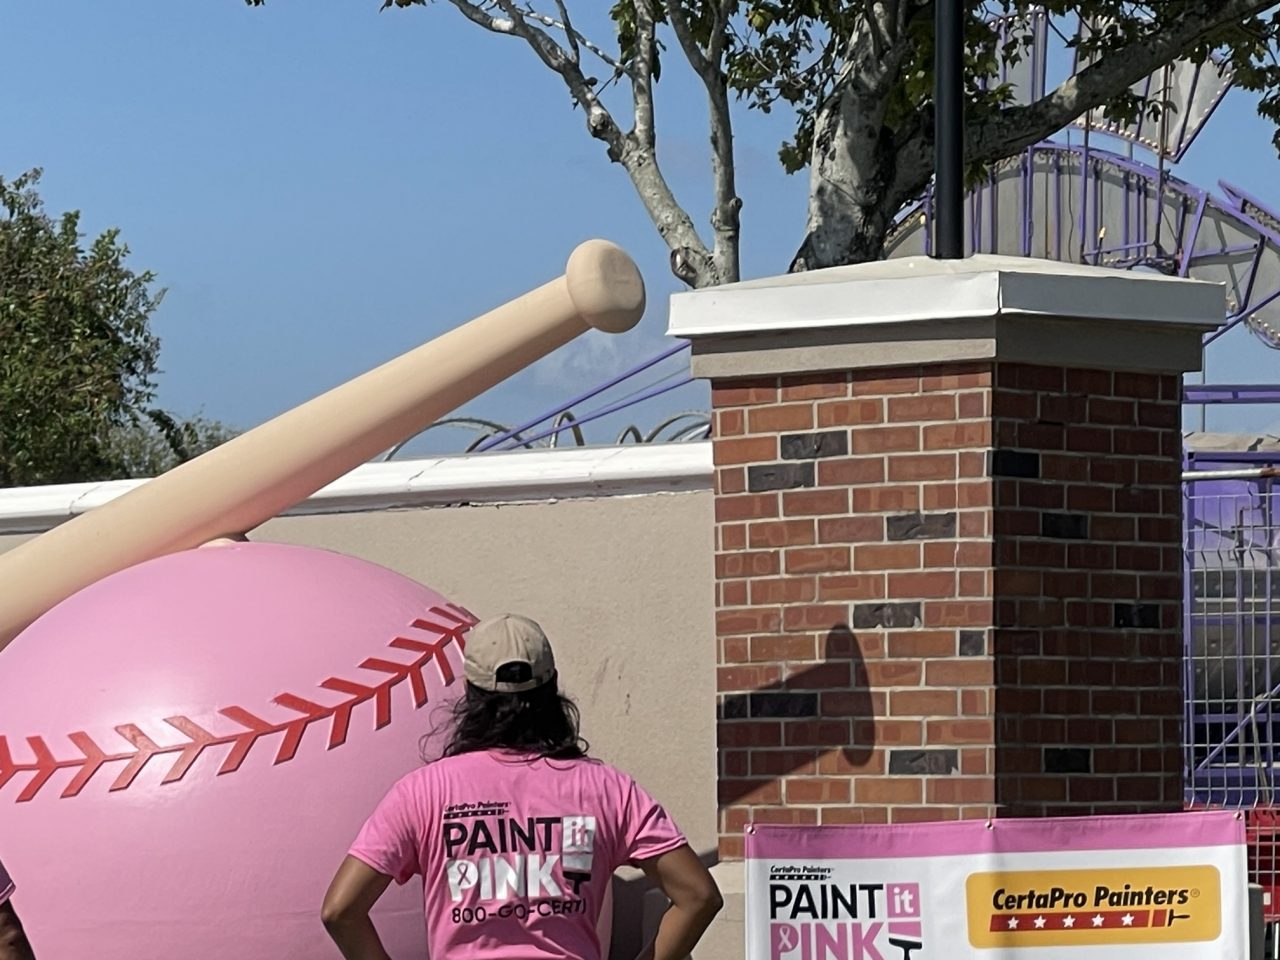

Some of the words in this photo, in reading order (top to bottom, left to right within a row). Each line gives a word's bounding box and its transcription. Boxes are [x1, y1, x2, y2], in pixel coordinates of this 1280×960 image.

[443, 817, 561, 858] PAINT
[571, 821, 588, 847] it
[447, 854, 562, 902] PINK
[992, 888, 1087, 910] CertaPro
[1094, 884, 1189, 907] Painters
[770, 884, 883, 919] PAINT
[893, 887, 914, 914] it
